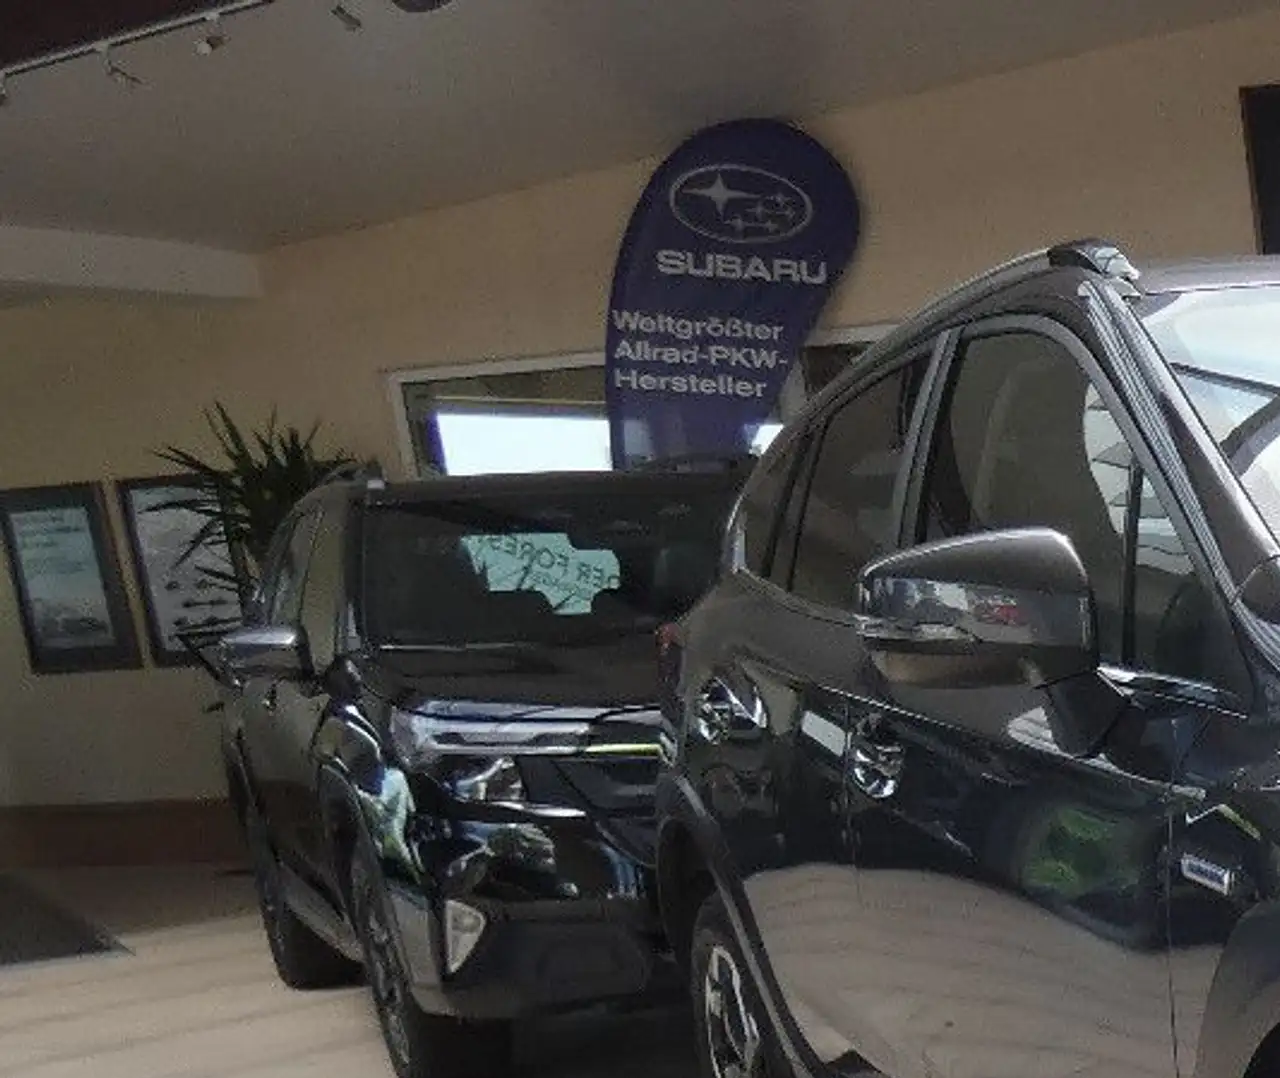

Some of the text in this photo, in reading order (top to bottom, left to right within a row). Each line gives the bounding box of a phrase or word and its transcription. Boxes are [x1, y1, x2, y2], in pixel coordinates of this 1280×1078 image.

[655, 249, 828, 285] SUBARU
[612, 309, 784, 340] Weltgrößter
[614, 340, 788, 369] Allrad-PKW-
[614, 368, 767, 397] Hersteller
